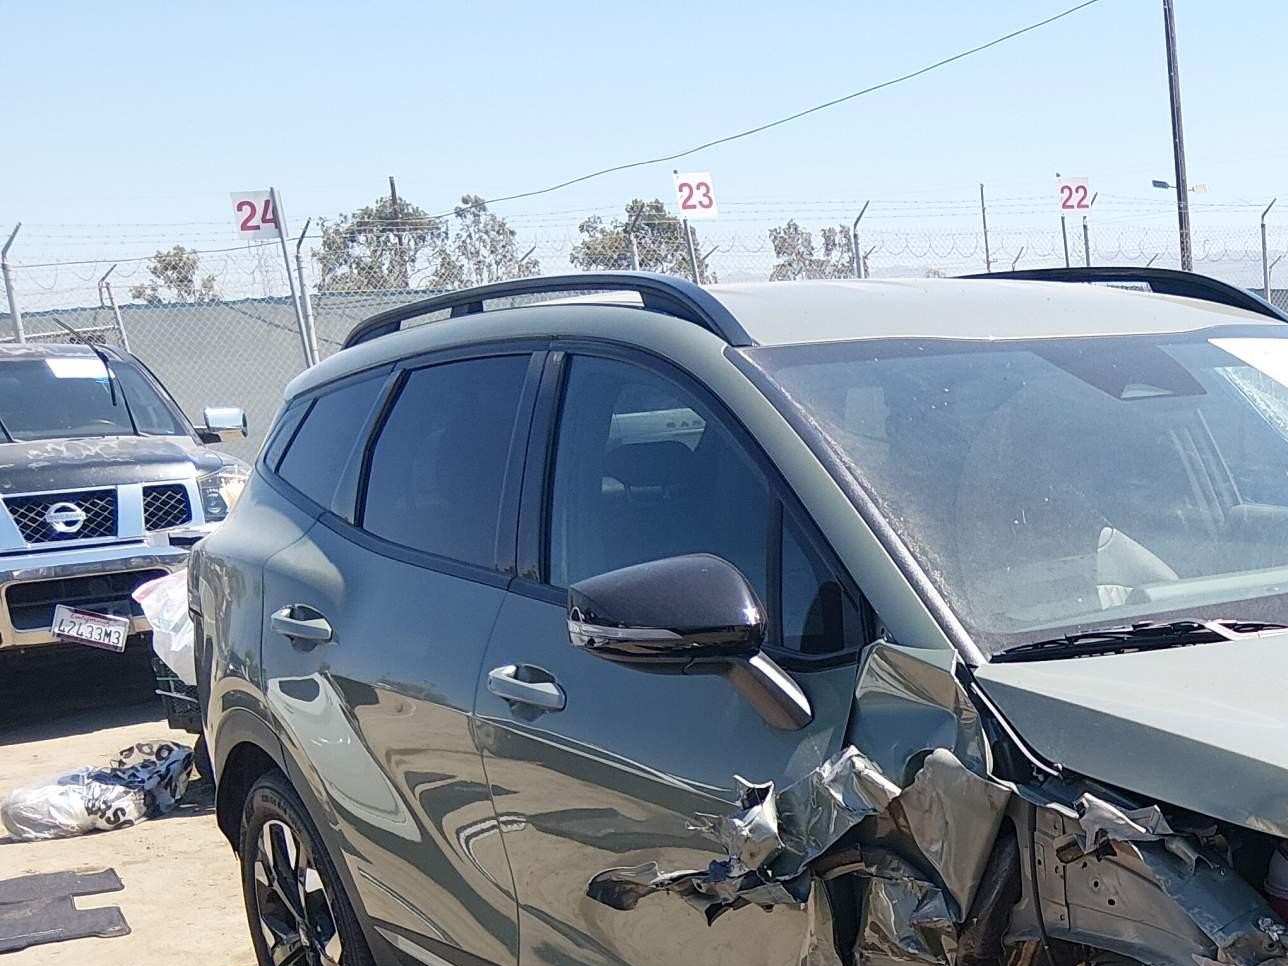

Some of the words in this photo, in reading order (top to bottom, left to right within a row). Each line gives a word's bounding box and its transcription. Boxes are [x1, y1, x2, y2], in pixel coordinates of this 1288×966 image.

[678, 182, 713, 209] 23
[1060, 185, 1089, 209] 22
[236, 200, 279, 230] 24
